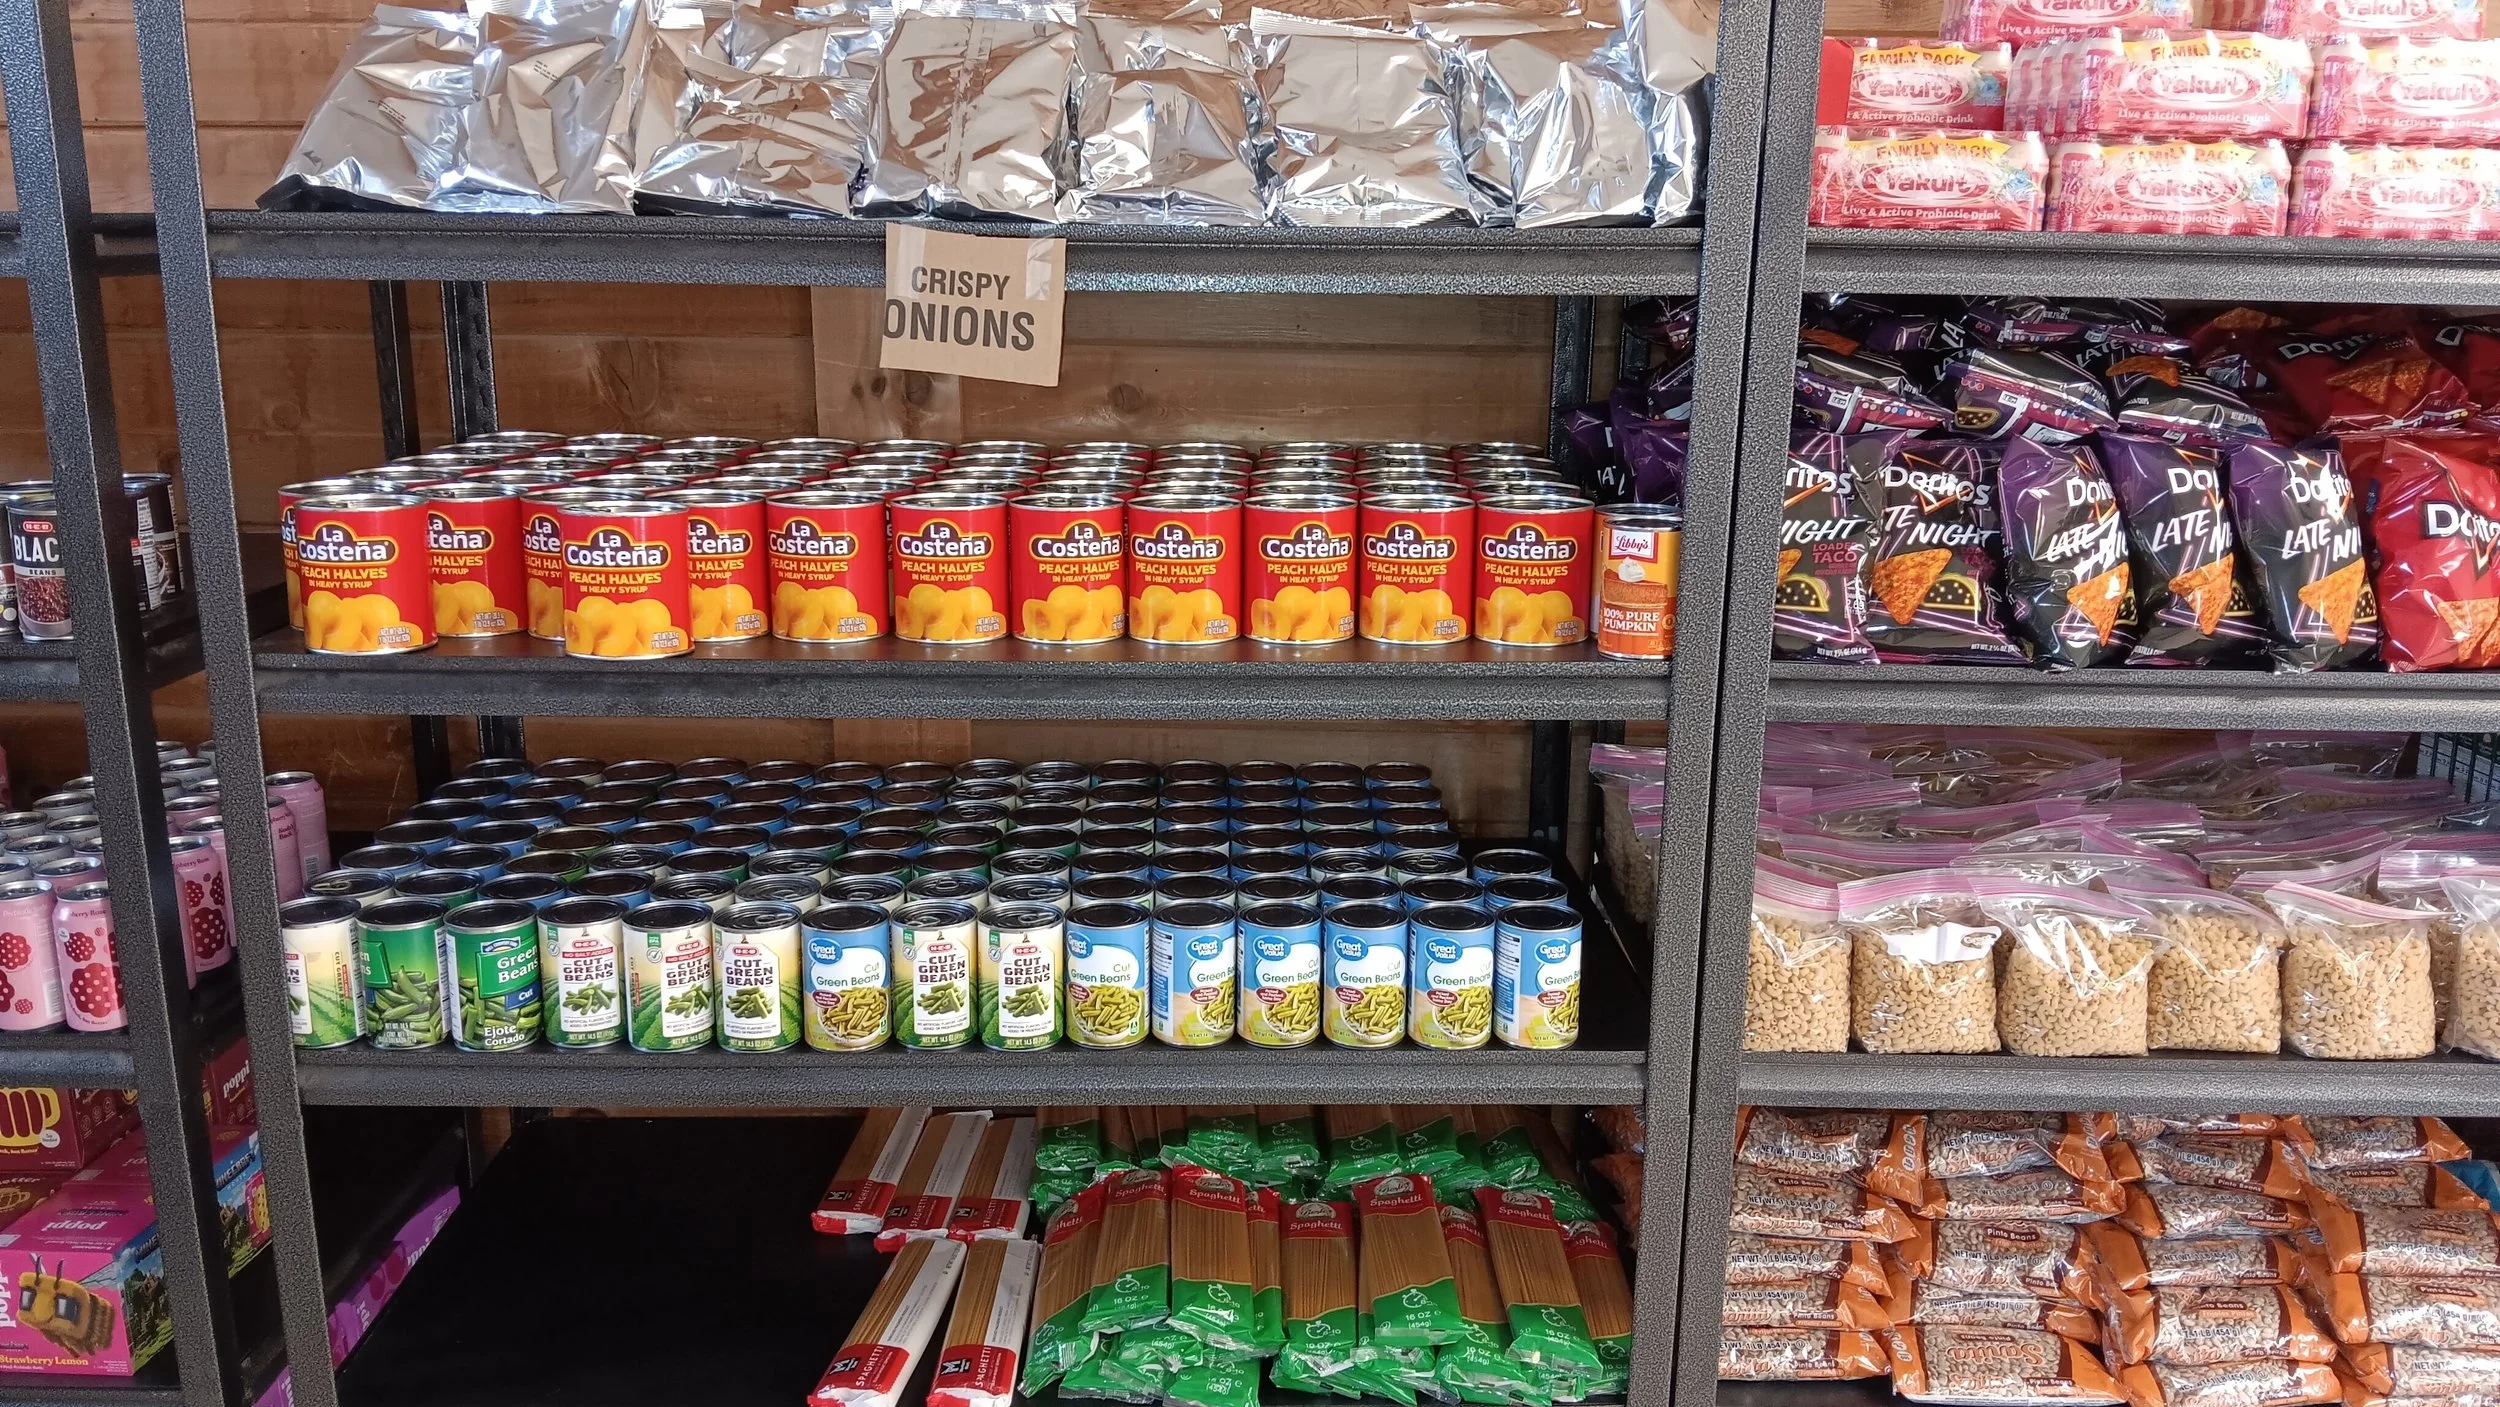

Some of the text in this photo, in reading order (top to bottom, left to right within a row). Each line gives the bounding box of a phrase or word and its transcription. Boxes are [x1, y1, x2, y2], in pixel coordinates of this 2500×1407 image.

[2001, 24, 2066, 35] Live & Active
[1859, 52, 1918, 66] FAMILY
[1868, 81, 1946, 99] Yakult
[2160, 76, 2243, 93] Yakult
[1862, 112, 1974, 123] Active Probiotic Drink
[2118, 110, 2139, 118] Live
[2154, 111, 2187, 120] Active
[2189, 112, 2240, 122] Probiotic
[1887, 175, 1969, 193] Yakult
[1869, 207, 1876, 215] &
[1879, 208, 1913, 216] Active
[1916, 209, 1970, 219] Probiotic
[1971, 211, 2001, 220] Drink
[912, 266, 1010, 300] CRISPY
[883, 299, 1034, 351] ONIONS
[1885, 467, 1990, 506] Doritos
[323, 528, 343, 542] La
[792, 523, 810, 536] La
[930, 525, 951, 538] La
[1075, 526, 1093, 539] La
[1164, 527, 1182, 540] La
[1303, 527, 1320, 541] La
[1395, 526, 1413, 541] La
[1516, 528, 1536, 542] La
[1907, 522, 2000, 545] NIGHT
[2153, 509, 2211, 551] LATE
[599, 533, 621, 547] La
[770, 536, 848, 554] Costeña
[1614, 535, 1648, 552] Libby's
[2282, 519, 2330, 559] LATE
[14, 535, 60, 562] BLAC
[300, 542, 387, 561] Costeña
[900, 537, 985, 555] Costeña
[1038, 538, 1119, 556] Costeña
[1135, 539, 1217, 557] Costeña
[1267, 539, 1349, 557] Costeña
[1367, 539, 1449, 557] Costeña
[1485, 541, 1569, 559] Costeña
[434, 556, 483, 566] HALVES
[568, 546, 662, 565] Costeña
[1813, 551, 1857, 563] TACO
[695, 559, 744, 570] HALVES
[771, 560, 848, 572] PEACH HALVES
[902, 560, 985, 573] PEACH HALVES
[1039, 560, 1119, 574] PEACH HALVES
[1136, 563, 1216, 575] PEACH HALVES
[1268, 563, 1347, 574] PEACH HALVES
[1368, 561, 1447, 574] PEACH HALVES
[1485, 564, 1568, 576] PEACH HALVES
[302, 568, 387, 579] PEACH HALVES
[570, 573, 661, 584] PEACH HALVES
[1603, 608, 1659, 621] 100% PURE
[1604, 620, 1656, 632] PUMPKIN
[810, 944, 836, 956] Great
[1191, 941, 1218, 951] Great
[1258, 941, 1284, 951] Great
[1336, 939, 1361, 951] Great
[1430, 943, 1456, 952] Great
[1540, 944, 1566, 953] Great
[497, 945, 537, 968] Green
[574, 957, 603, 966] CUT
[929, 955, 955, 964] CUT
[1014, 957, 1041, 967] CUT
[498, 958, 538, 983] Beans
[563, 962, 613, 974] GREEN
[667, 963, 710, 979] GREEN
[678, 960, 703, 970] CUT
[726, 967, 773, 976] GREEN
[864, 962, 879, 973] Cut
[918, 962, 965, 973] GREEN
[1004, 964, 1050, 976] GREEN
[1113, 964, 1131, 972] Cut
[565, 970, 613, 981] BEANS
[668, 971, 711, 986] BEANS
[727, 977, 773, 986] BEANS
[816, 973, 880, 987] Green Beans
[919, 971, 966, 982] BEANS
[1004, 973, 1050, 985] BEANS
[1071, 970, 1130, 983] Green Beans
[1197, 971, 1226, 982] Green
[1262, 968, 1319, 983] Green Beans
[1340, 972, 1401, 983] Green Beans
[1433, 972, 1491, 985] Green Beans
[1545, 976, 1572, 986] Green
[519, 989, 533, 1000] Cut
[484, 1025, 516, 1038] Ejote
[485, 1033, 524, 1046] Cortado
[223, 1059, 250, 1098] poppi
[1778, 1178, 1799, 1186] Pinto
[2218, 1179, 2262, 1192] Pinto Beans
[1116, 1184, 1166, 1198] Spaghetti
[1190, 1189, 1241, 1204] Spaghetti
[1370, 1194, 1423, 1207] Spaghetti
[1499, 1207, 1551, 1221] Spaghetti
[1290, 1221, 1341, 1230] Spaghetti
[1987, 1228, 2036, 1241] Pinto Beans
[1731, 1255, 1747, 1263] NET
[2025, 1277, 2046, 1286] Pinto
[1409, 1321, 1432, 1329] (454g)
[0, 1355, 88, 1366] Strawberry Lemon
[856, 1346, 884, 1387] SPAGHETTI
[977, 1347, 991, 1387] SPAGHETTI
